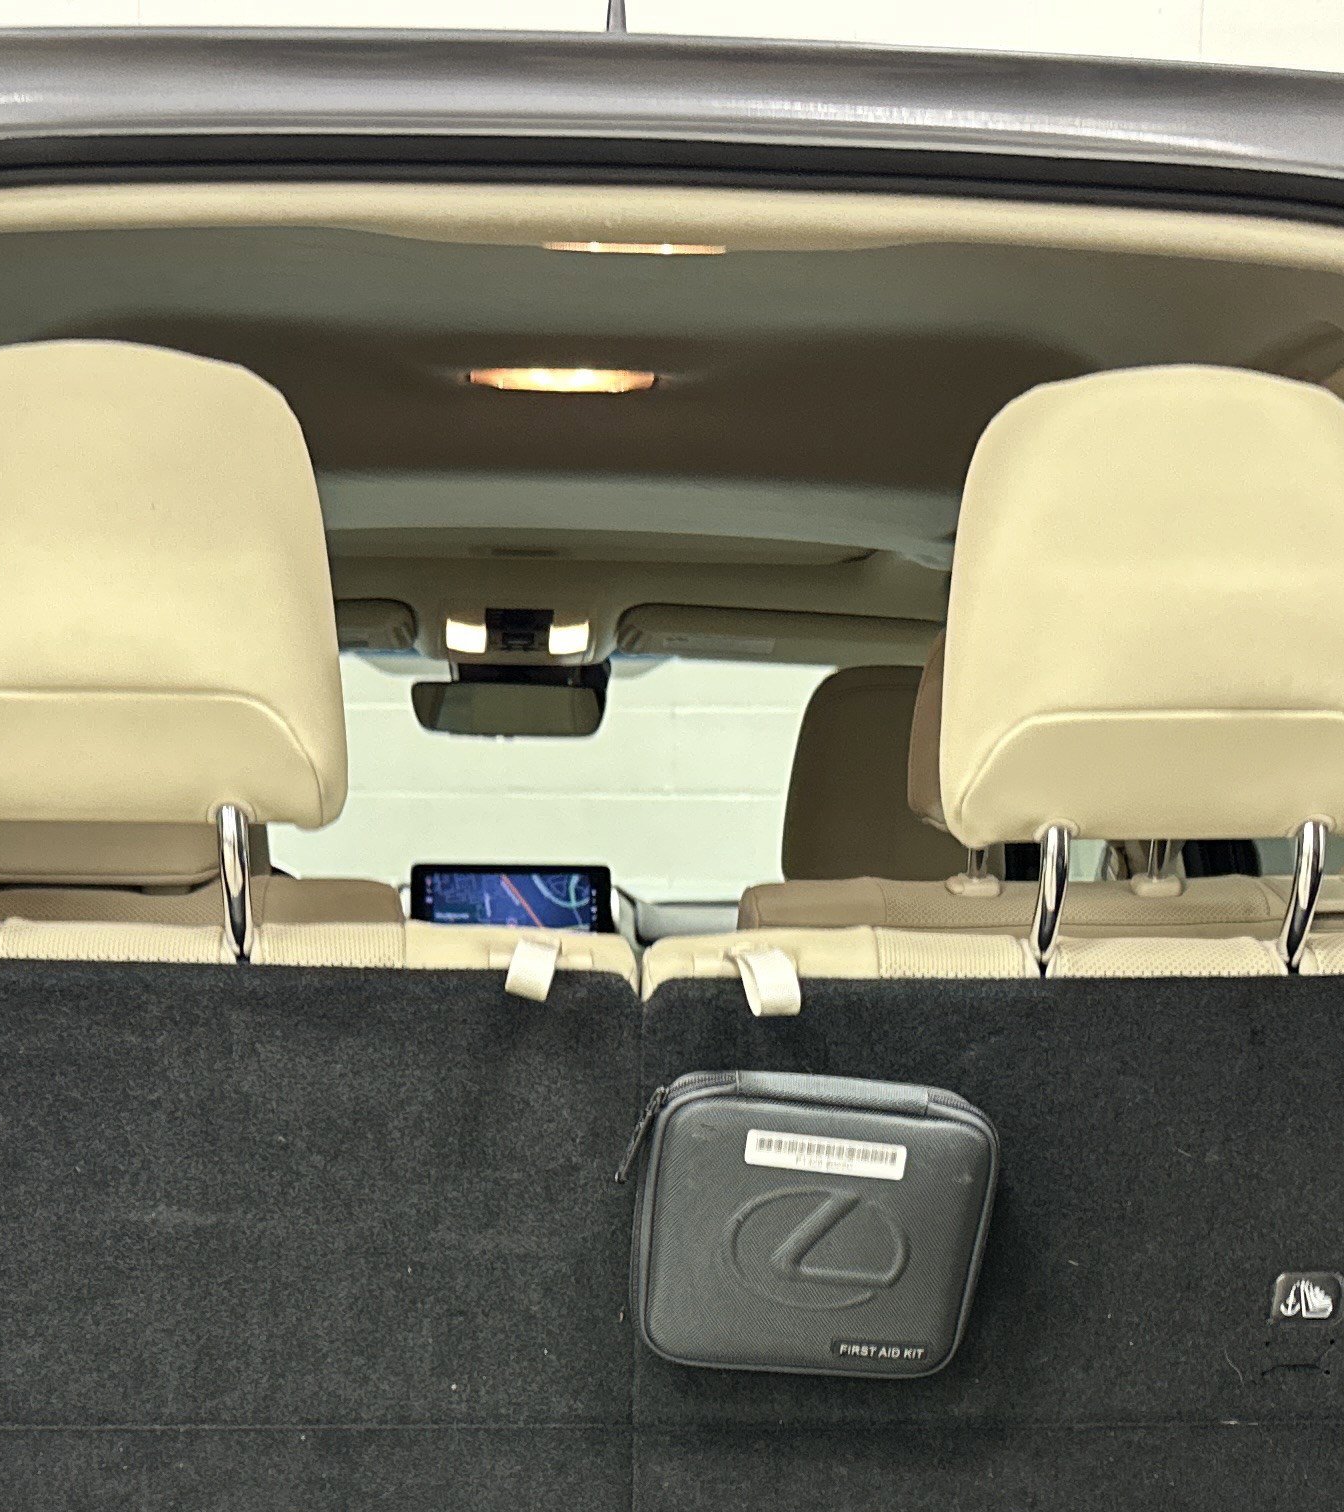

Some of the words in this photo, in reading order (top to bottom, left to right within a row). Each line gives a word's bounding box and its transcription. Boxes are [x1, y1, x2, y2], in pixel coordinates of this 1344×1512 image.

[839, 1343, 877, 1357] FIRST
[878, 1346, 901, 1358] AID
[903, 1347, 925, 1359] KIT
